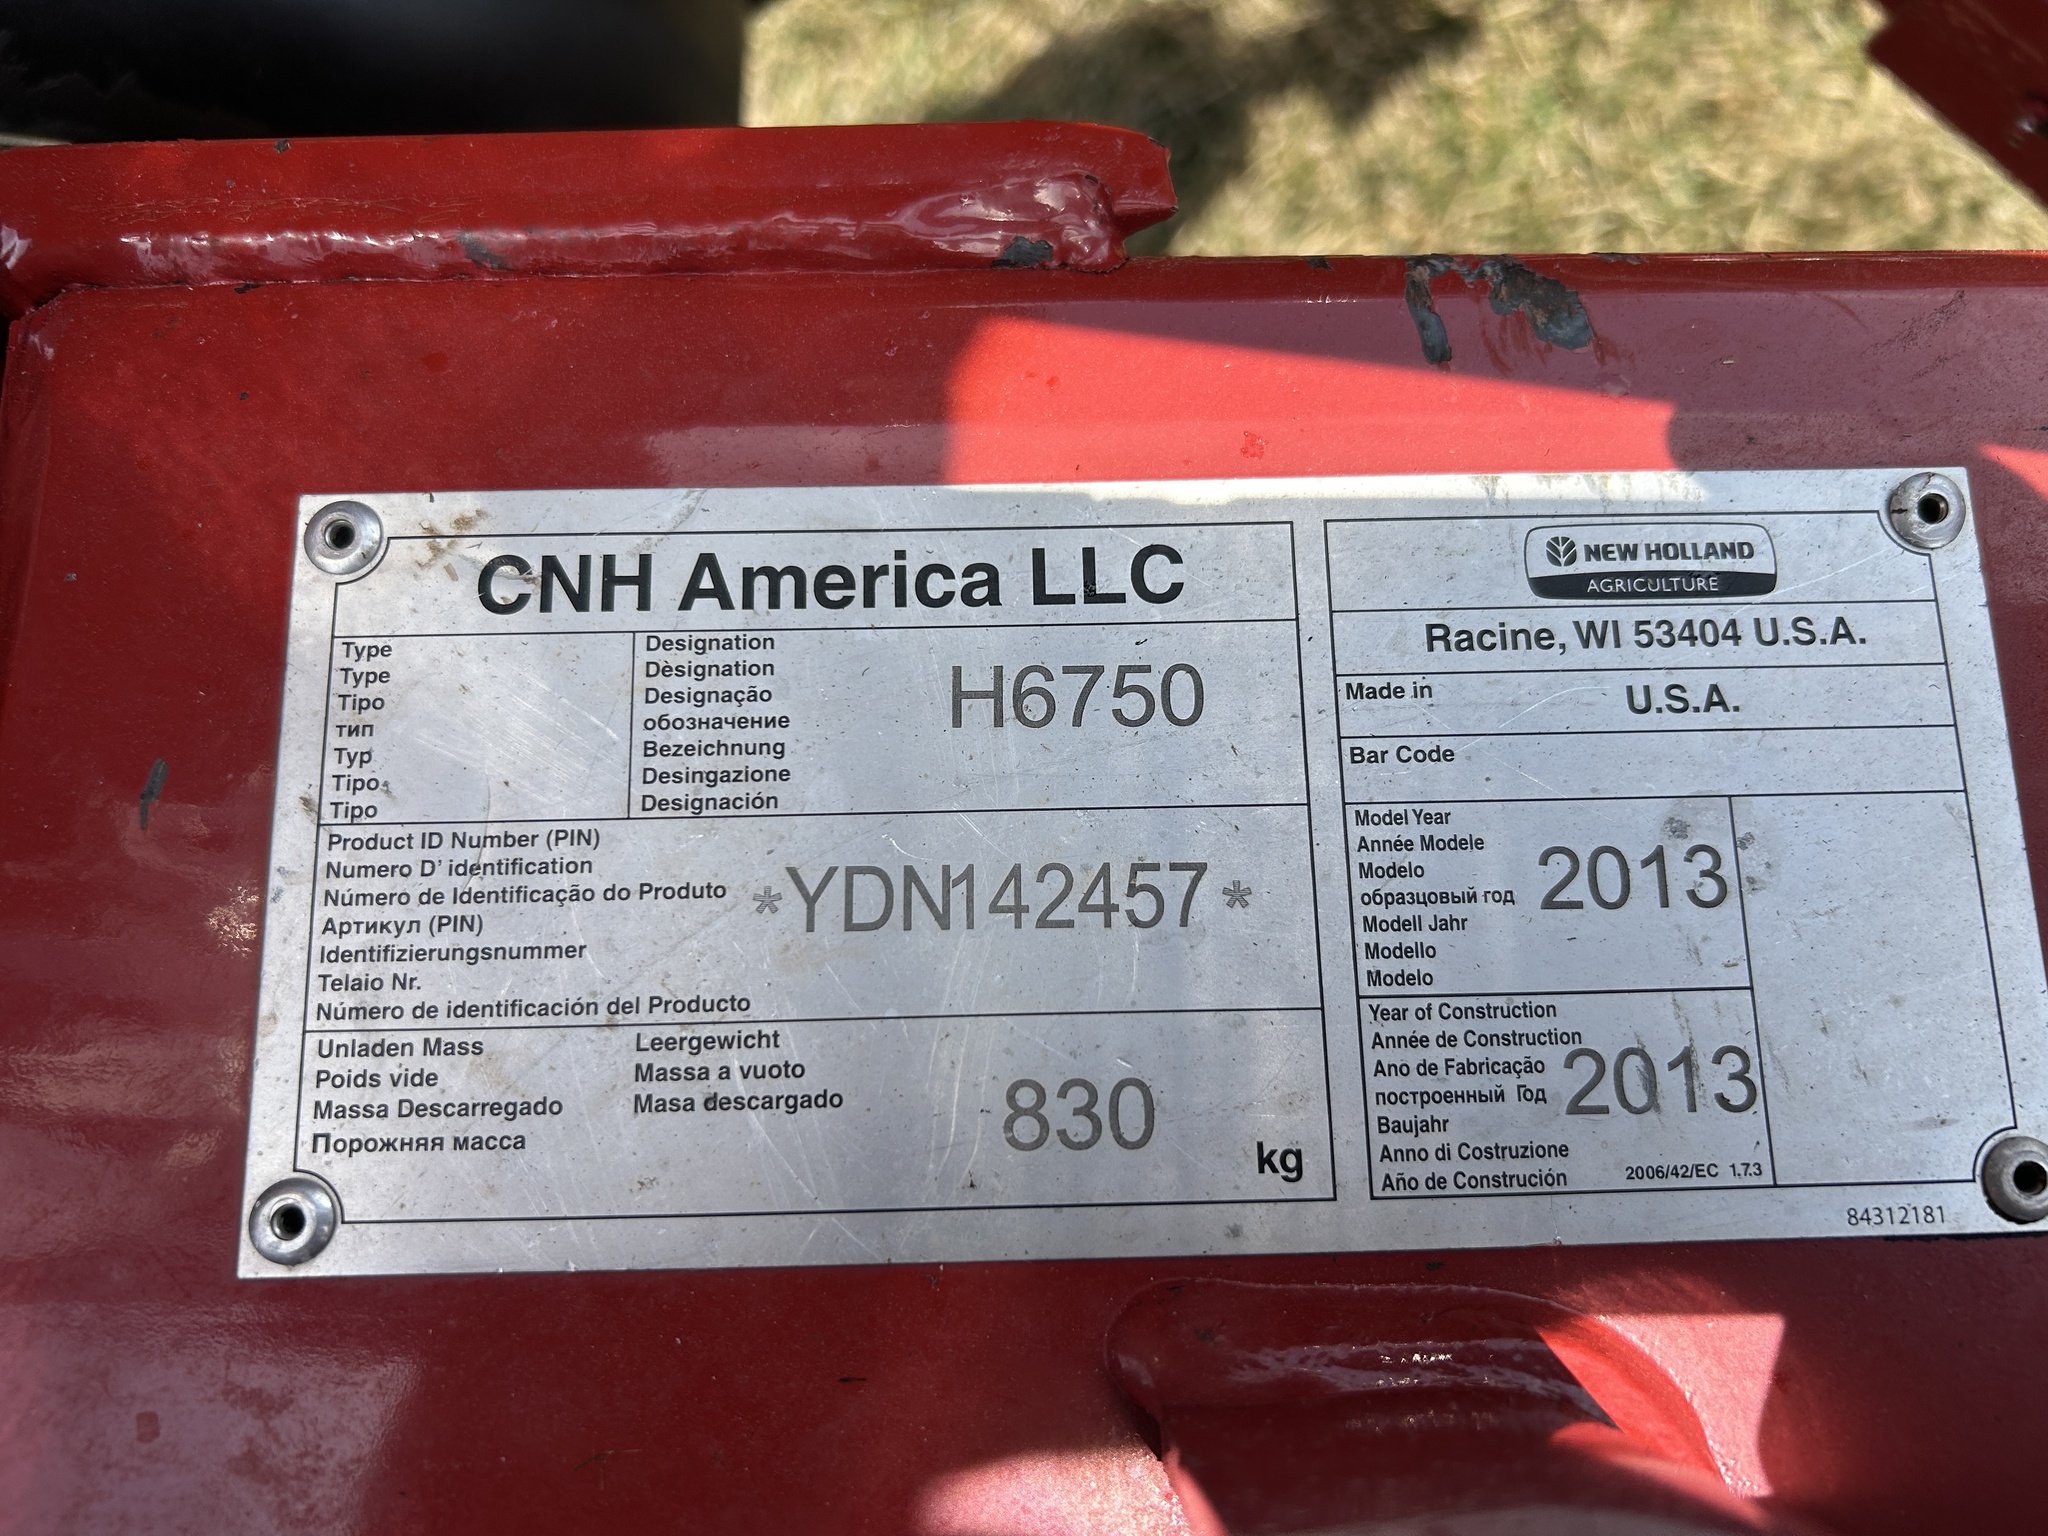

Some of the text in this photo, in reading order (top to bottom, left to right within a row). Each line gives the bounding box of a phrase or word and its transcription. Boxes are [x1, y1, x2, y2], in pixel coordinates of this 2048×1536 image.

[1584, 541, 1755, 562] NEW HOLLAND
[477, 544, 1185, 615] CNH America LLC
[1586, 576, 1719, 593] AGRICULTURE
[646, 633, 775, 655] Designation
[1425, 615, 1868, 655] Racine, WI 53404 U.S.A.
[342, 641, 393, 662] Type
[340, 667, 391, 688] Type
[645, 660, 775, 681] Dèsignation
[644, 685, 772, 707] Designação
[951, 663, 1205, 728] H6750
[1345, 681, 1433, 701] Made in
[1625, 684, 1740, 715] U.S.A.
[338, 693, 385, 714] Tipo
[336, 722, 374, 739] тип
[644, 712, 790, 731] обозначение
[334, 747, 372, 769] Typ
[644, 738, 785, 760] Bezeichnung
[1350, 745, 1455, 765] Bar Code
[332, 774, 379, 795] Tipo
[642, 765, 791, 787] Desingazione
[330, 801, 378, 823] Tipo
[641, 791, 778, 813] Designación
[1355, 810, 1451, 826] Model Year
[328, 828, 600, 852] Product ID Number (PIN)
[1357, 835, 1484, 852] Année Modele
[325, 861, 413, 879] Numero
[448, 856, 593, 877] identification
[1359, 862, 1425, 879] Modelo
[1537, 844, 1728, 910] 2013
[324, 881, 727, 908] Número de Identificação do Produto
[1361, 887, 1515, 907] образцовый год
[322, 913, 484, 937] Артикул (PIN)
[1363, 915, 1468, 932] Modell Jahr
[320, 943, 587, 966] Identifizierungsnummer
[1365, 943, 1436, 960] Modello
[318, 973, 421, 992] Telaio Nr.
[1366, 970, 1434, 986] Modelo
[316, 994, 751, 1021] Número de identificación del Producto
[1369, 1002, 1557, 1022] Year of Construction
[318, 1038, 484, 1059] Unladen Mass
[635, 1031, 781, 1055] Leergewicht
[1371, 1029, 1582, 1049] Année de Construction
[634, 1061, 805, 1083] Massa a vuoto
[1373, 1057, 1545, 1078] Ano de Fabricação
[316, 1069, 439, 1089] Poids vide
[1563, 1045, 1757, 1115] 2013
[633, 1090, 843, 1115] Masa descargado
[1375, 1085, 1547, 1107] построенный Год
[313, 1097, 564, 1121] Massa Descarregado
[1003, 1078, 1155, 1151] 830
[1377, 1117, 1449, 1138] Baujahr
[312, 1133, 527, 1158] Порожняя масса
[1379, 1142, 1569, 1162] Anno di Costruzione
[1257, 1141, 1302, 1182] kg
[1625, 1164, 1762, 1180] 2006/42/EC 1.7.3
[1382, 1170, 1567, 1191] Año de Construción
[1847, 1206, 1944, 1226] 84312181
